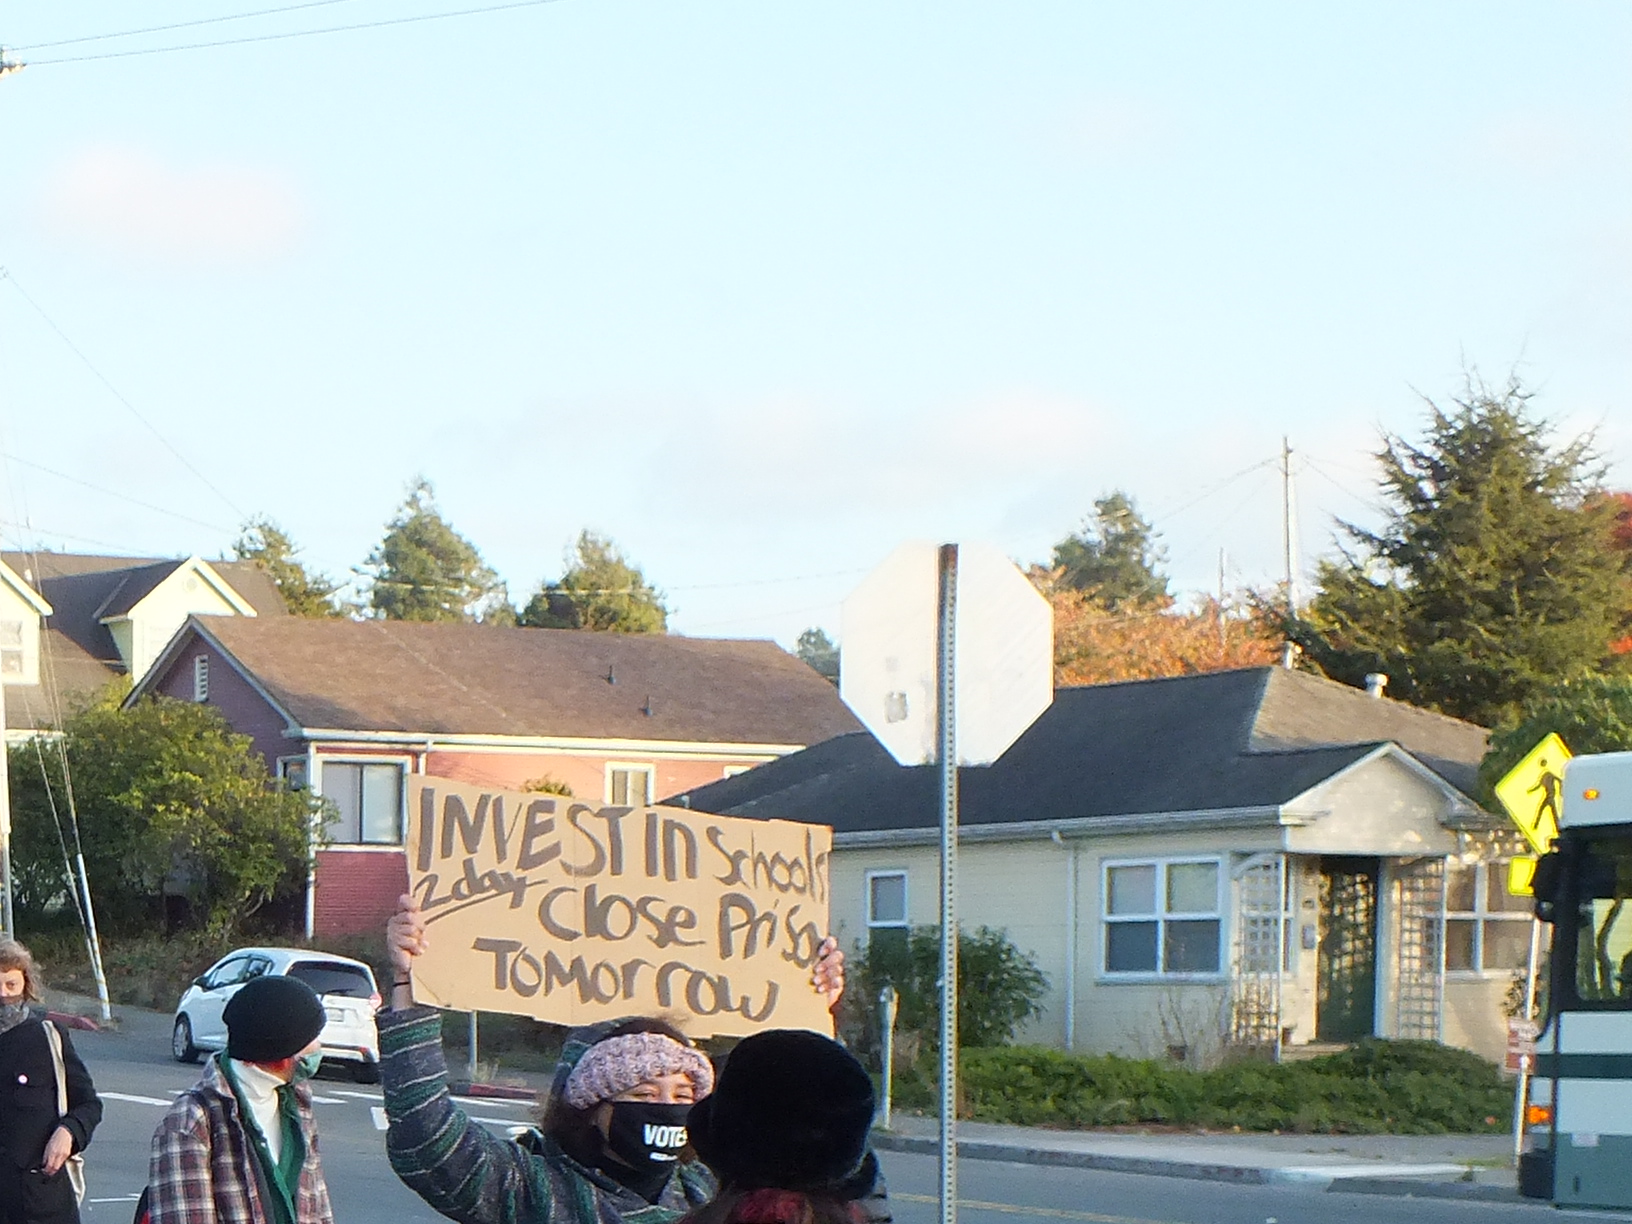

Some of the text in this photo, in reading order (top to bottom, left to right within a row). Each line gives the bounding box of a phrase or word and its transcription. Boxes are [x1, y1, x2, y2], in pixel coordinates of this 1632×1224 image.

[415, 787, 637, 877] INVEST
[706, 825, 828, 904] Schools
[414, 858, 548, 910] 2day
[538, 883, 824, 970] Close Priso
[643, 1123, 688, 1148] VOTE
